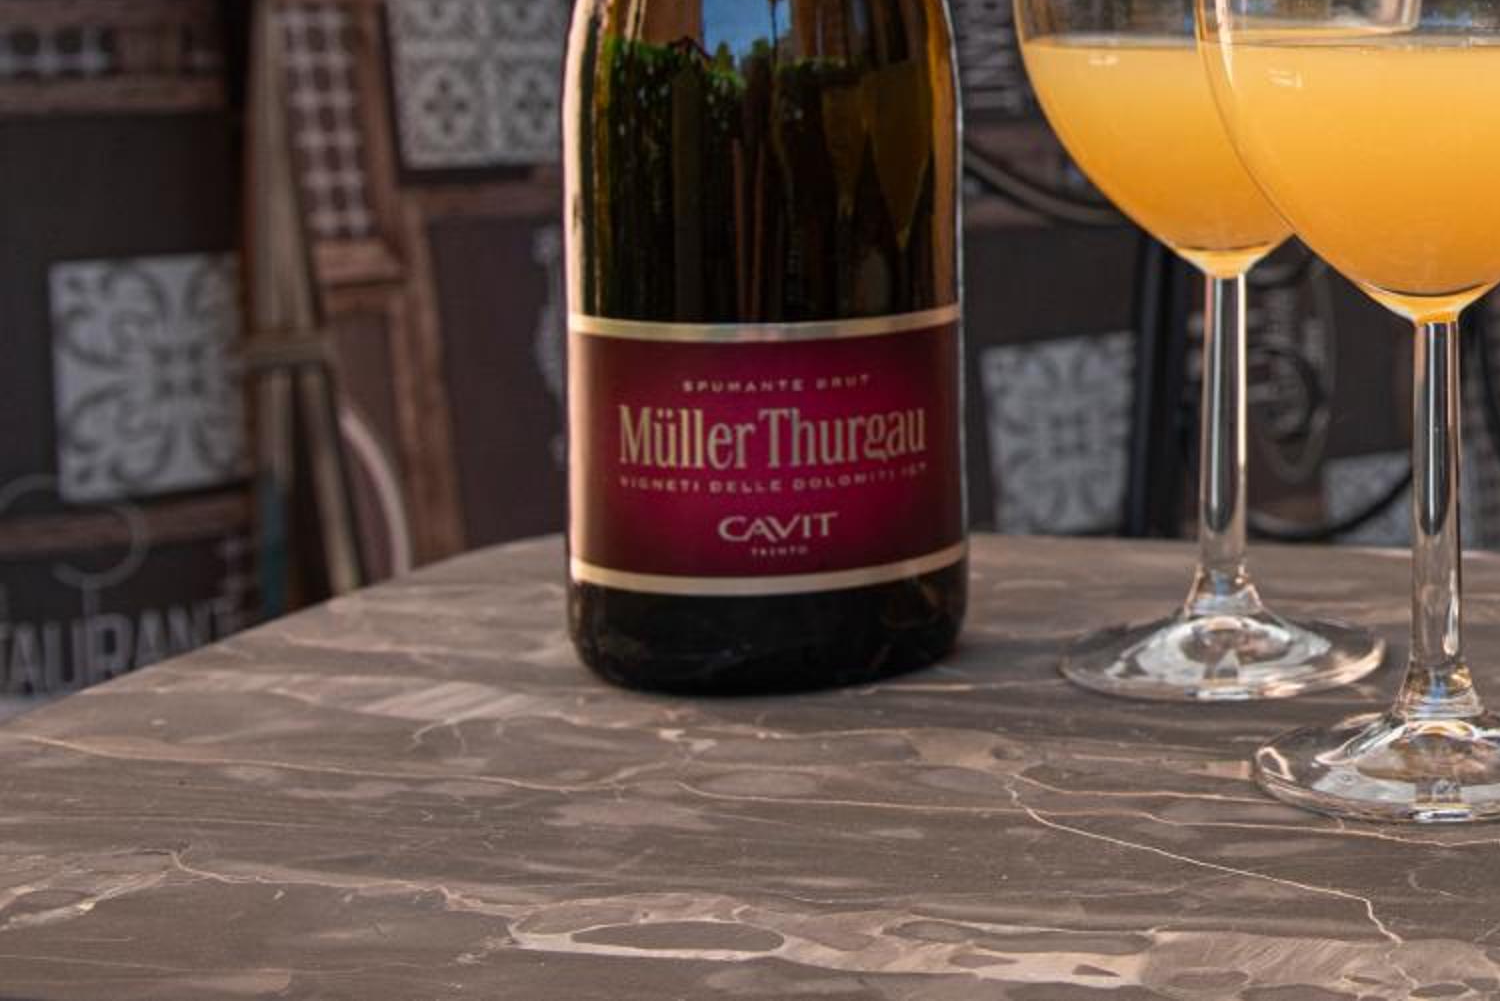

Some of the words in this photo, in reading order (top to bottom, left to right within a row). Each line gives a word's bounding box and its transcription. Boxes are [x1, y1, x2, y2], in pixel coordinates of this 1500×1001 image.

[682, 377, 805, 393] SPUMANTE
[815, 373, 870, 390] BRUT
[618, 403, 755, 471] Müller
[757, 406, 927, 470] Thurgau
[619, 475, 700, 493] VIGNETI
[708, 479, 783, 494] DELLE
[791, 468, 896, 492] DOLOMITI
[717, 510, 838, 543] CAVIT
